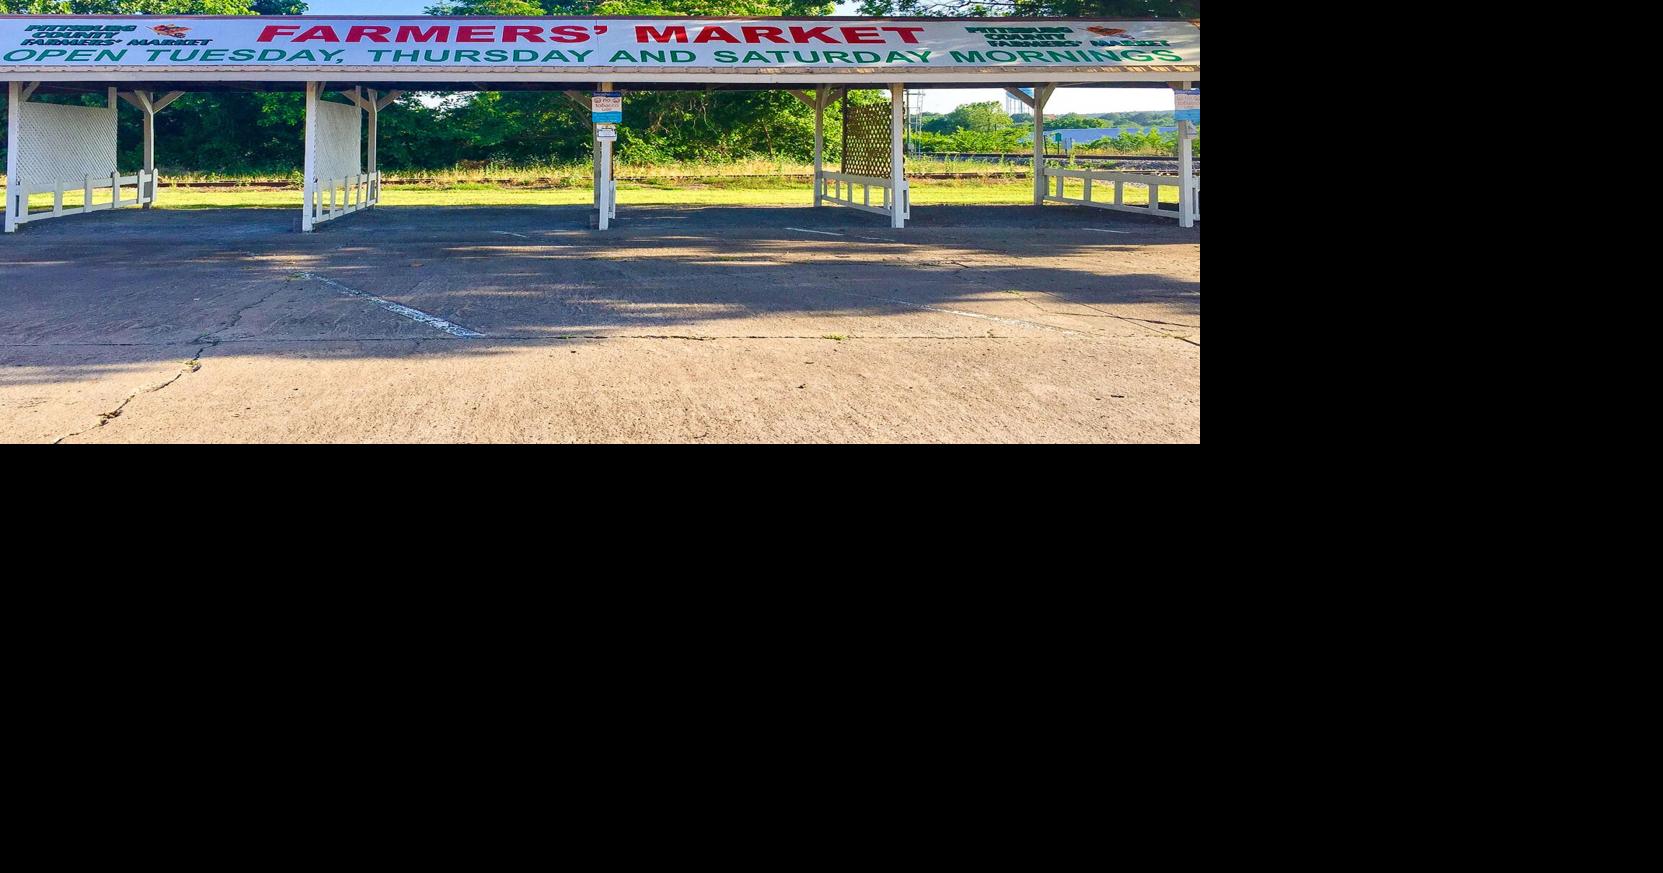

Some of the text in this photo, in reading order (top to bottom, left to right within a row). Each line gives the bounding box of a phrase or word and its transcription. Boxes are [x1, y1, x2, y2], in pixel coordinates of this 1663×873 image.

[31, 31, 121, 39] COUNTY
[256, 25, 925, 44] FARMERS' MARKET
[126, 38, 214, 46] MARKET
[3, 49, 1184, 64] OPEN TUESDAY, THURSDAY AND SATURDAY MORNINGS
